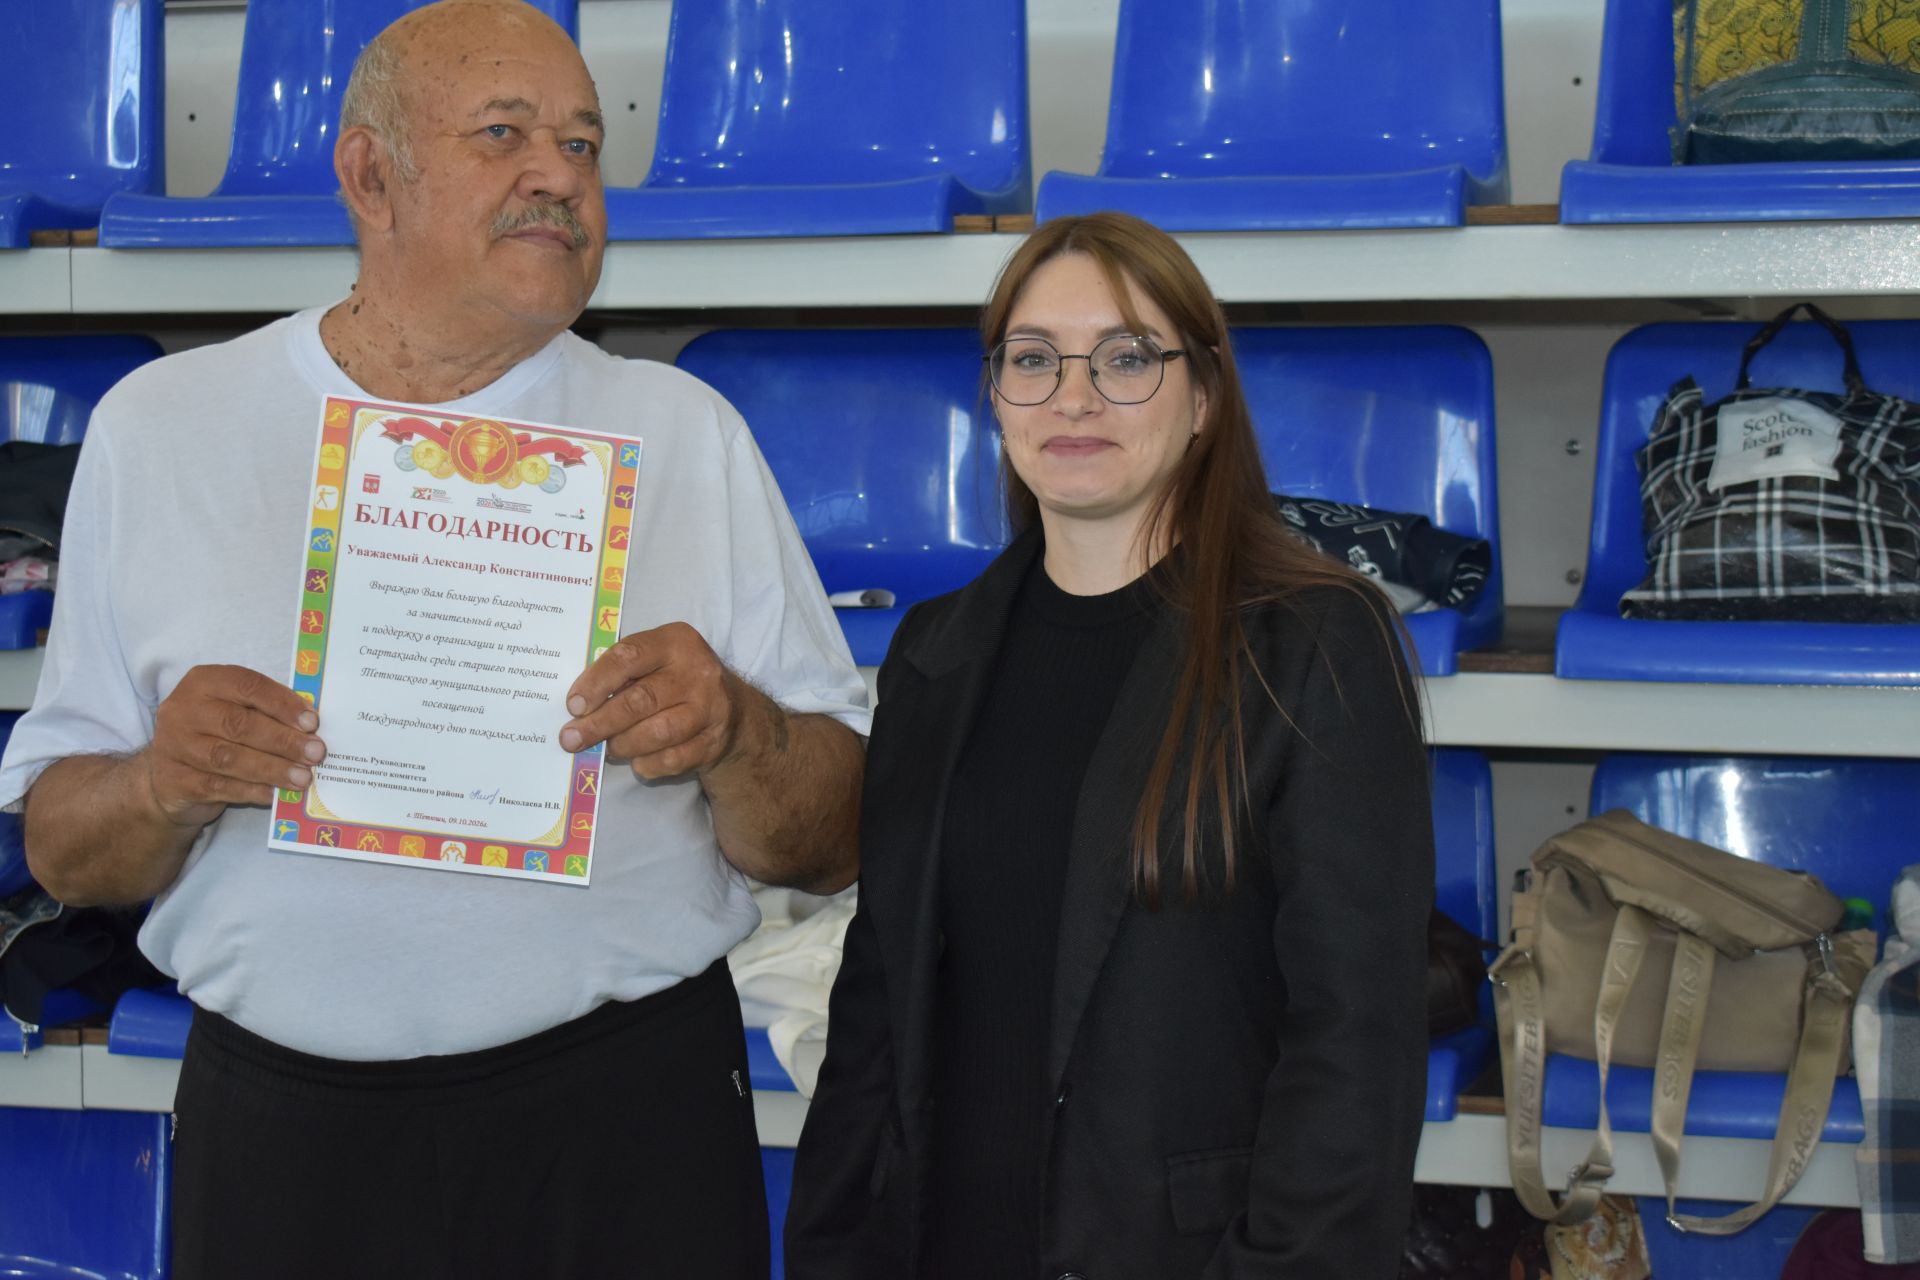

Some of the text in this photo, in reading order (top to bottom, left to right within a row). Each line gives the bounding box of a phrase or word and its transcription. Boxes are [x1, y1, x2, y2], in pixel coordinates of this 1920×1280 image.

[1743, 428, 1813, 451] fashion
[354, 503, 594, 553] БЛАГОДАРНОСТЬ
[347, 544, 593, 586] Уважаемый Александр Константинович!
[369, 580, 564, 614] Выражаю Вам большую благодарность
[406, 608, 522, 631] за значительный вклад
[362, 625, 369, 633] и
[371, 626, 424, 643] поддержку
[433, 634, 496, 651] организации
[497, 643, 504, 651] и
[506, 644, 561, 658] проведении
[359, 645, 559, 680] Спартакиады среди старшего поколения
[361, 667, 550, 702] Тетюшского муниципального района,
[422, 698, 485, 715] посвященной
[357, 711, 547, 744] Международному дню пожилых людей
[317, 763, 427, 782] Исполнительного комитета
[327, 752, 426, 770] меститель Руководителя
[316, 773, 366, 785] Тетюшского
[367, 781, 435, 796] муниципального
[436, 790, 465, 800] района
[499, 797, 543, 808] Николаева
[544, 802, 561, 810] Н.В.
